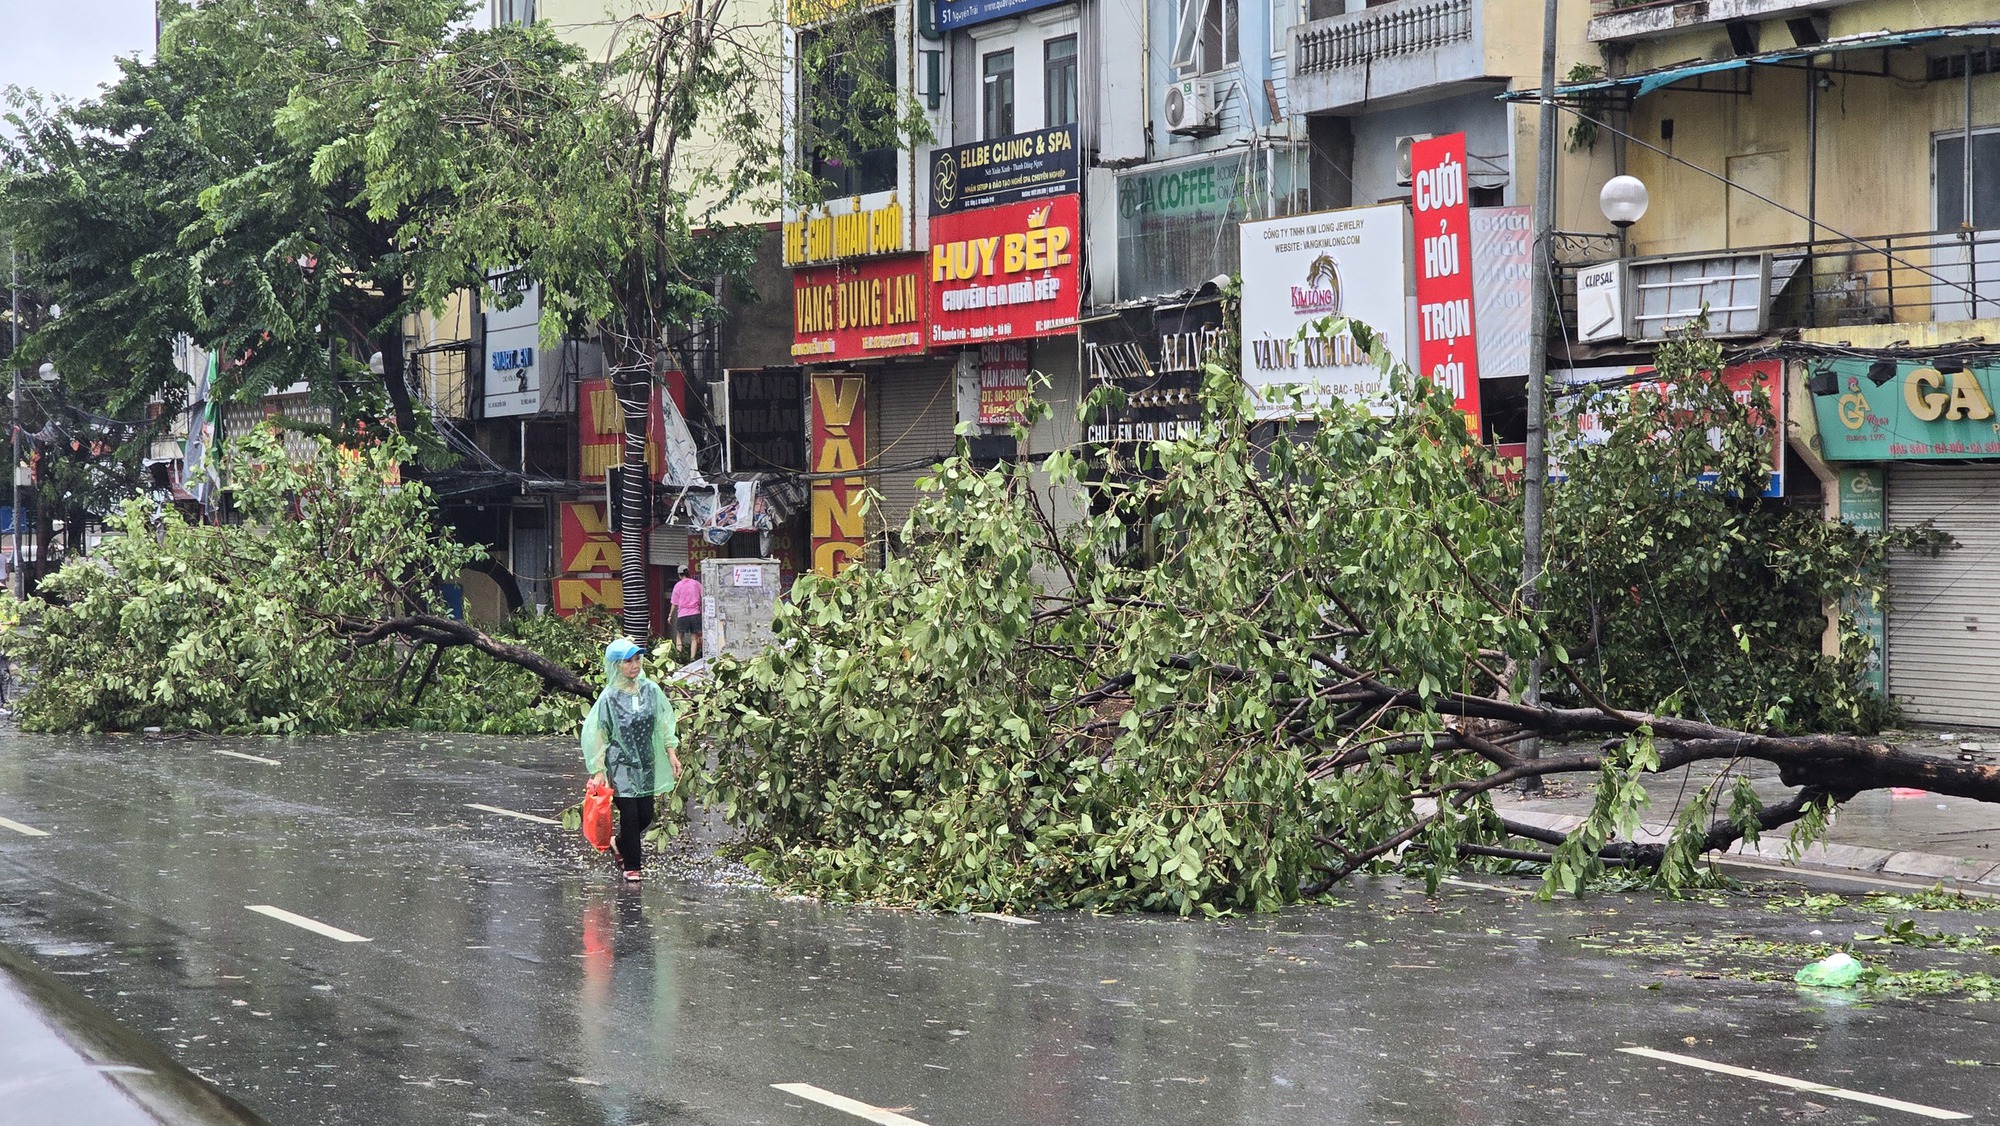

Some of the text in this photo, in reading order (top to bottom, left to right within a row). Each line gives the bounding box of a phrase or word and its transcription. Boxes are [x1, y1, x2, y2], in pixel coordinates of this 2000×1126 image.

[942, 9, 951, 23] 51
[961, 130, 1072, 169] ELLBE CLINIC & SPA
[1157, 166, 1216, 211] COFFEE
[1416, 152, 1464, 212] CƯỚI
[784, 211, 806, 266] THẾ
[808, 206, 832, 262] GIỚI
[872, 194, 903, 253] CƯỚI
[1263, 218, 1365, 241] CÔNG TY TNHH KIM LONG JEWELRY
[1275, 234, 1361, 254] WEBSITE: VANGKIMLONG.COM
[1424, 219, 1460, 279] HỎI
[932, 236, 1000, 283] HUY
[942, 283, 987, 312] CHUYÊN
[1008, 276, 1035, 305] NHÀ
[1034, 269, 1061, 301] BẾP
[1585, 271, 1613, 288] CLIPSAL
[797, 275, 834, 334] VÀNG
[886, 274, 917, 325] LAN
[1421, 299, 1471, 346] TRỌN
[933, 324, 942, 342] 51
[1252, 330, 1299, 370] VÀNG
[981, 345, 1000, 363] CHO
[734, 373, 797, 400] VÀNG
[981, 364, 1028, 388] VĂN PHÒNG
[1333, 383, 1349, 398] BẠC
[1366, 378, 1382, 394] QUÝ
[1432, 353, 1466, 400] GÓI
[1904, 367, 1995, 423] GA
[982, 390, 993, 403] DT:
[734, 400, 799, 433] NHẪN
[1135, 422, 1154, 443] GIA
[1158, 414, 1200, 442] NGÀNH
[740, 437, 798, 467] CƯỚI
[813, 377, 865, 577] VÀNG
[559, 504, 624, 611] VÀN
